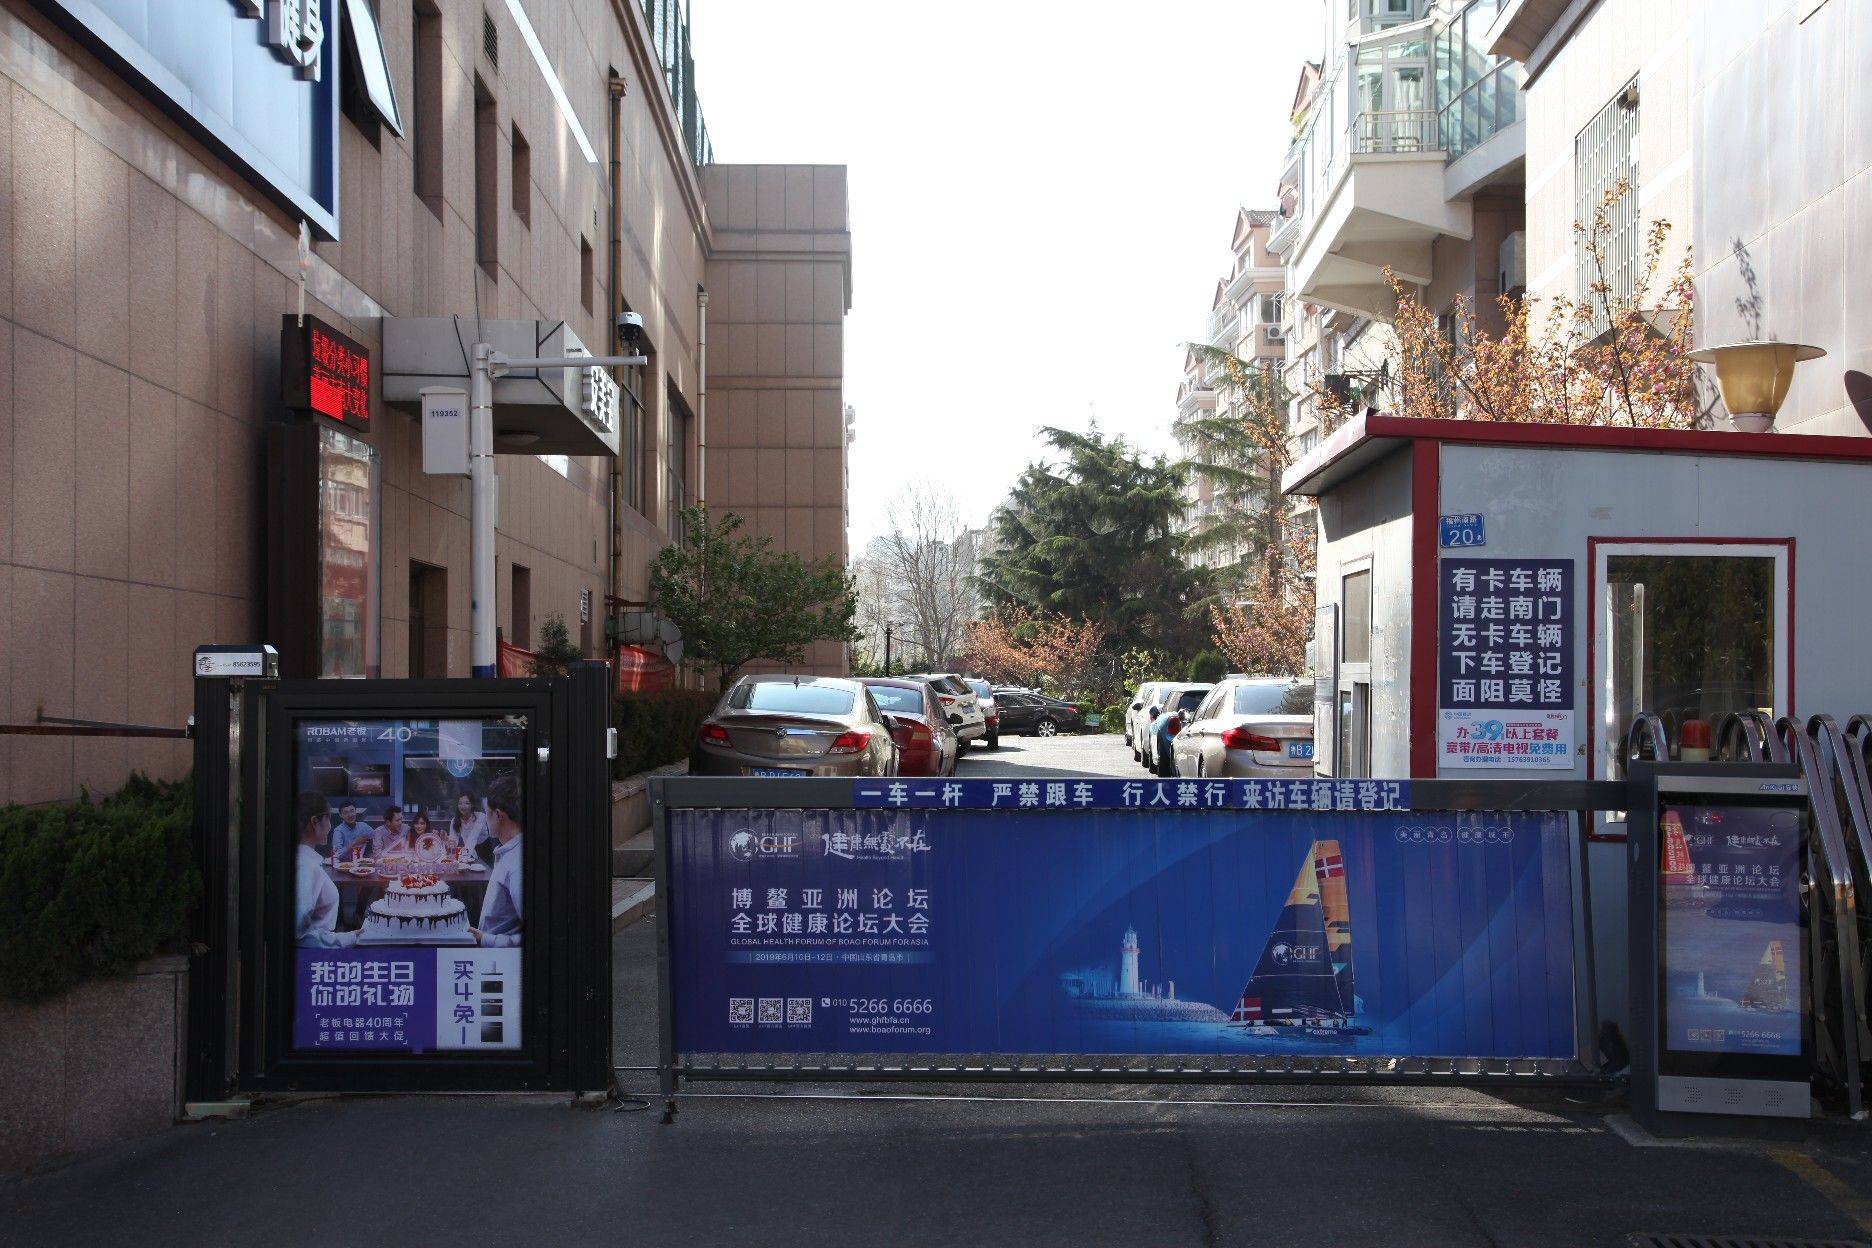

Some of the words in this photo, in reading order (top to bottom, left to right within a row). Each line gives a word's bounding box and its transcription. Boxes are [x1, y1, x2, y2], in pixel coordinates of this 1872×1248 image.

[1452, 567, 1563, 592] 有卡车辆
[1452, 595, 1562, 620] 请走南门
[1452, 623, 1562, 647] 无卡车辆
[1452, 651, 1562, 675] 下车登记
[1452, 678, 1562, 703] 面阻莫怪
[1446, 741, 1567, 755] 宽带/高清电视免费用
[860, 782, 963, 807] 一车一杆
[992, 782, 1094, 807] 严禁跟车
[1122, 781, 1226, 806] 行人禁行
[1242, 780, 1402, 810] 来访车辆请登记
[731, 887, 929, 910] 博鳌亚洲论坛
[731, 912, 930, 934] 全球健康论坛大会
[731, 938, 762, 946] GLOBAL
[764, 938, 794, 946] HEALTH
[795, 938, 825, 946] FORUM
[826, 938, 837, 946] OF
[838, 938, 861, 946] BOAO
[862, 938, 891, 946] FORUM
[892, 938, 908, 946] FOR
[909, 938, 929, 946] ASIA
[310, 961, 414, 983] 我的生日
[310, 984, 415, 1006] 你的礼物
[832, 998, 848, 1007] 010
[850, 998, 888, 1013] 5266
[893, 998, 932, 1013] 6666
[319, 1017, 404, 1028] 老板电器40周年
[850, 1016, 910, 1025] www.ghfbfa.cn
[850, 1025, 931, 1034] www.boaoforum.org
[319, 1030, 405, 1041] 超值回馈大促
